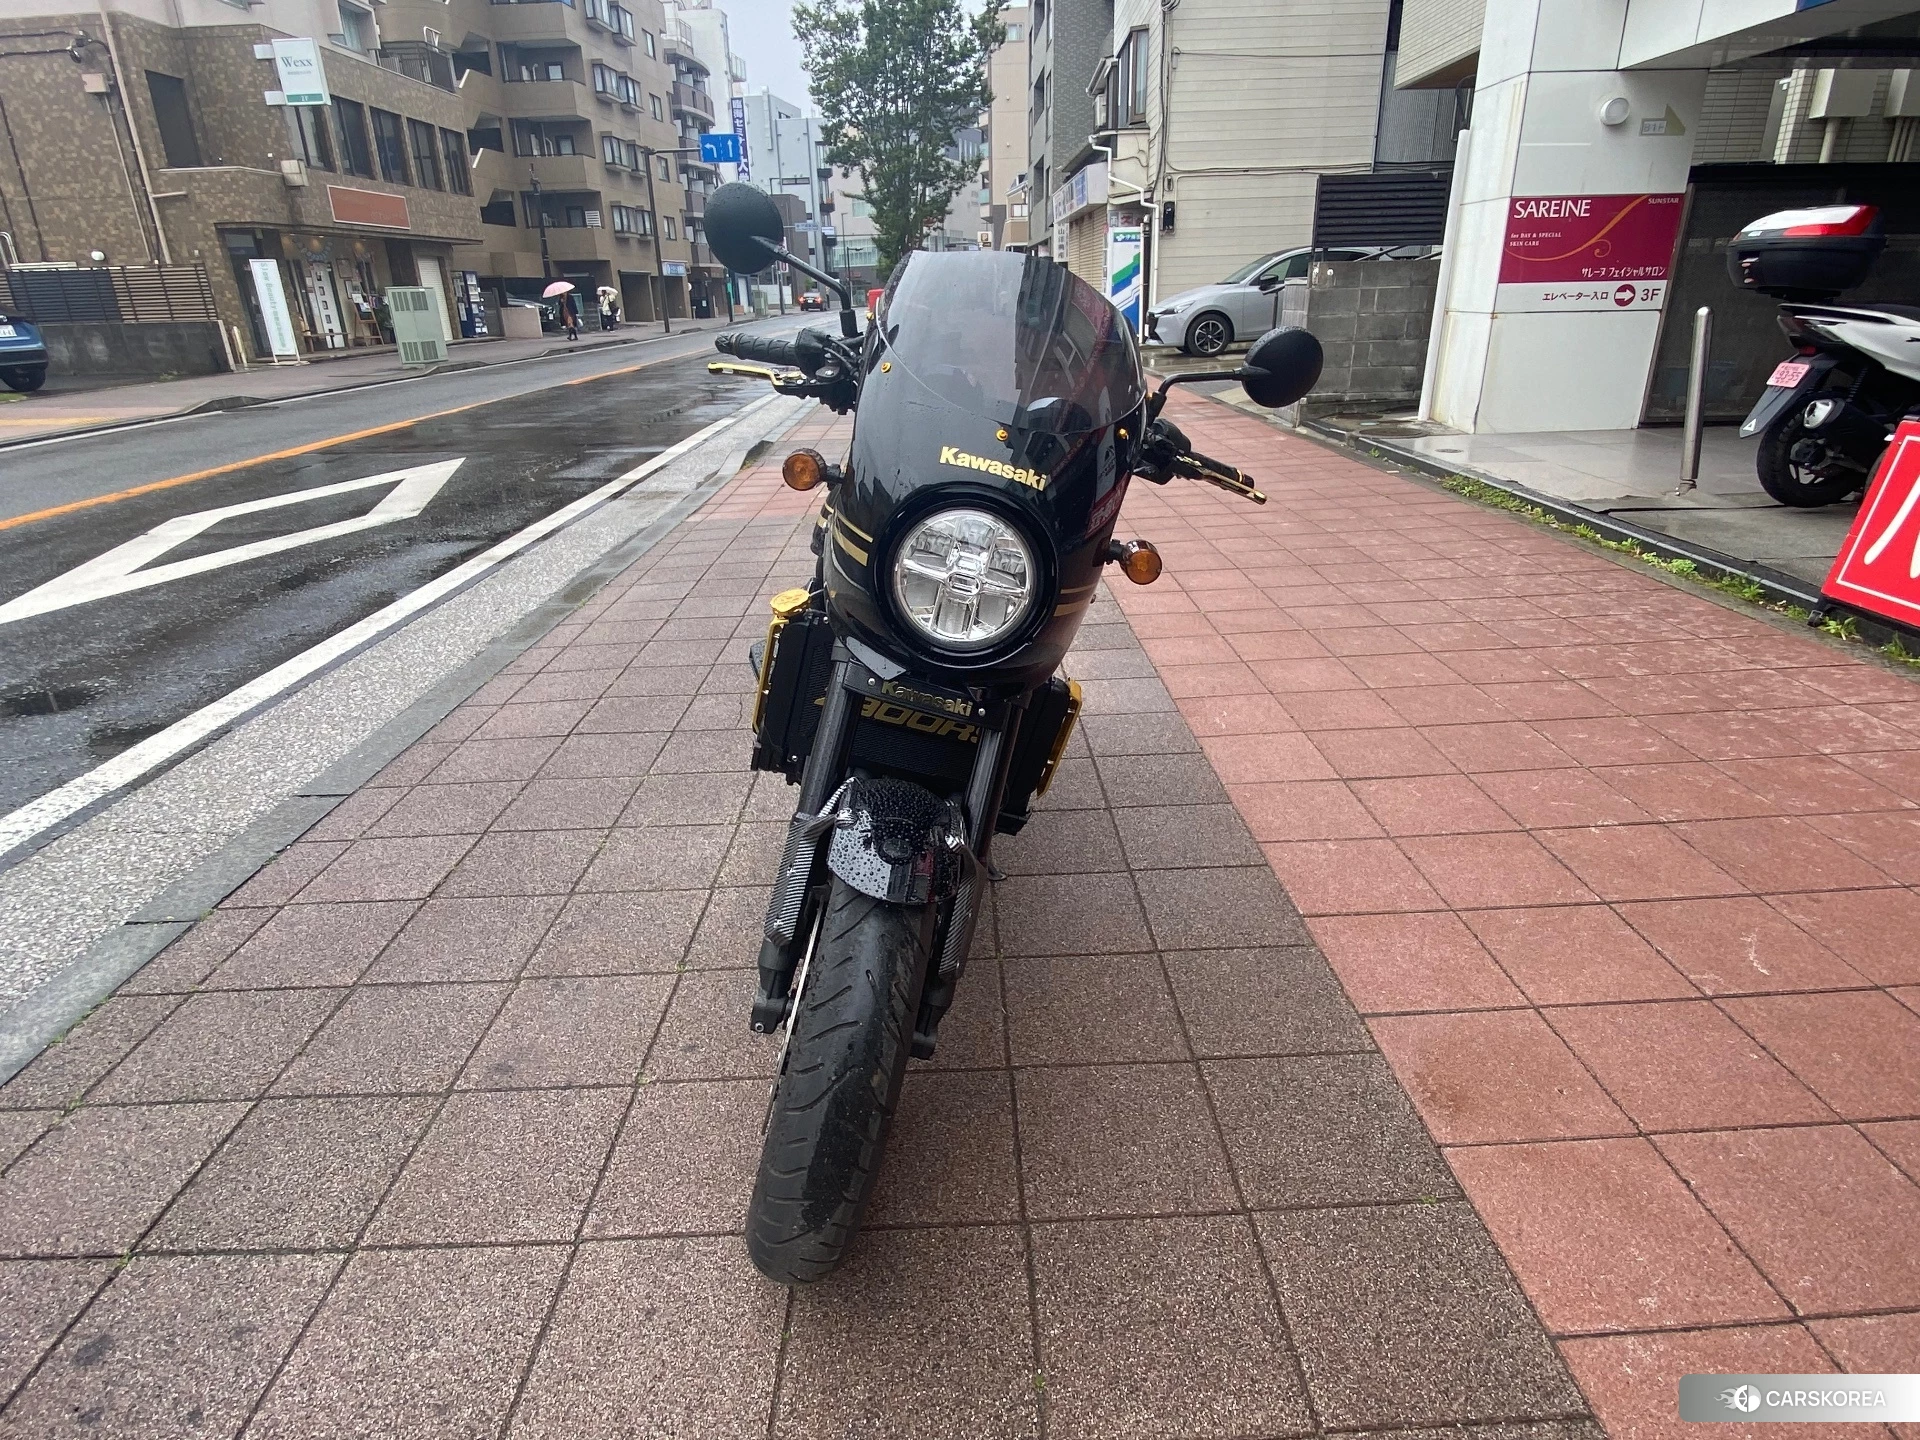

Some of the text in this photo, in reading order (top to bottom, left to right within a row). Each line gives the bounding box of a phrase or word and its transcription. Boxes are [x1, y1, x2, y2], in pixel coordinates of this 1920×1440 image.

[281, 56, 313, 67] Wexx
[1648, 197, 1679, 205] SUNSTAR
[1513, 199, 1592, 218] SAREINE
[1581, 266, 1666, 278] サレーヌ フェイシャルサロン
[1542, 291, 1609, 301] エレベーター入口
[1640, 288, 1661, 301] 3F
[939, 446, 1047, 492] Kawasaki
[881, 681, 973, 717] Kawasaki
